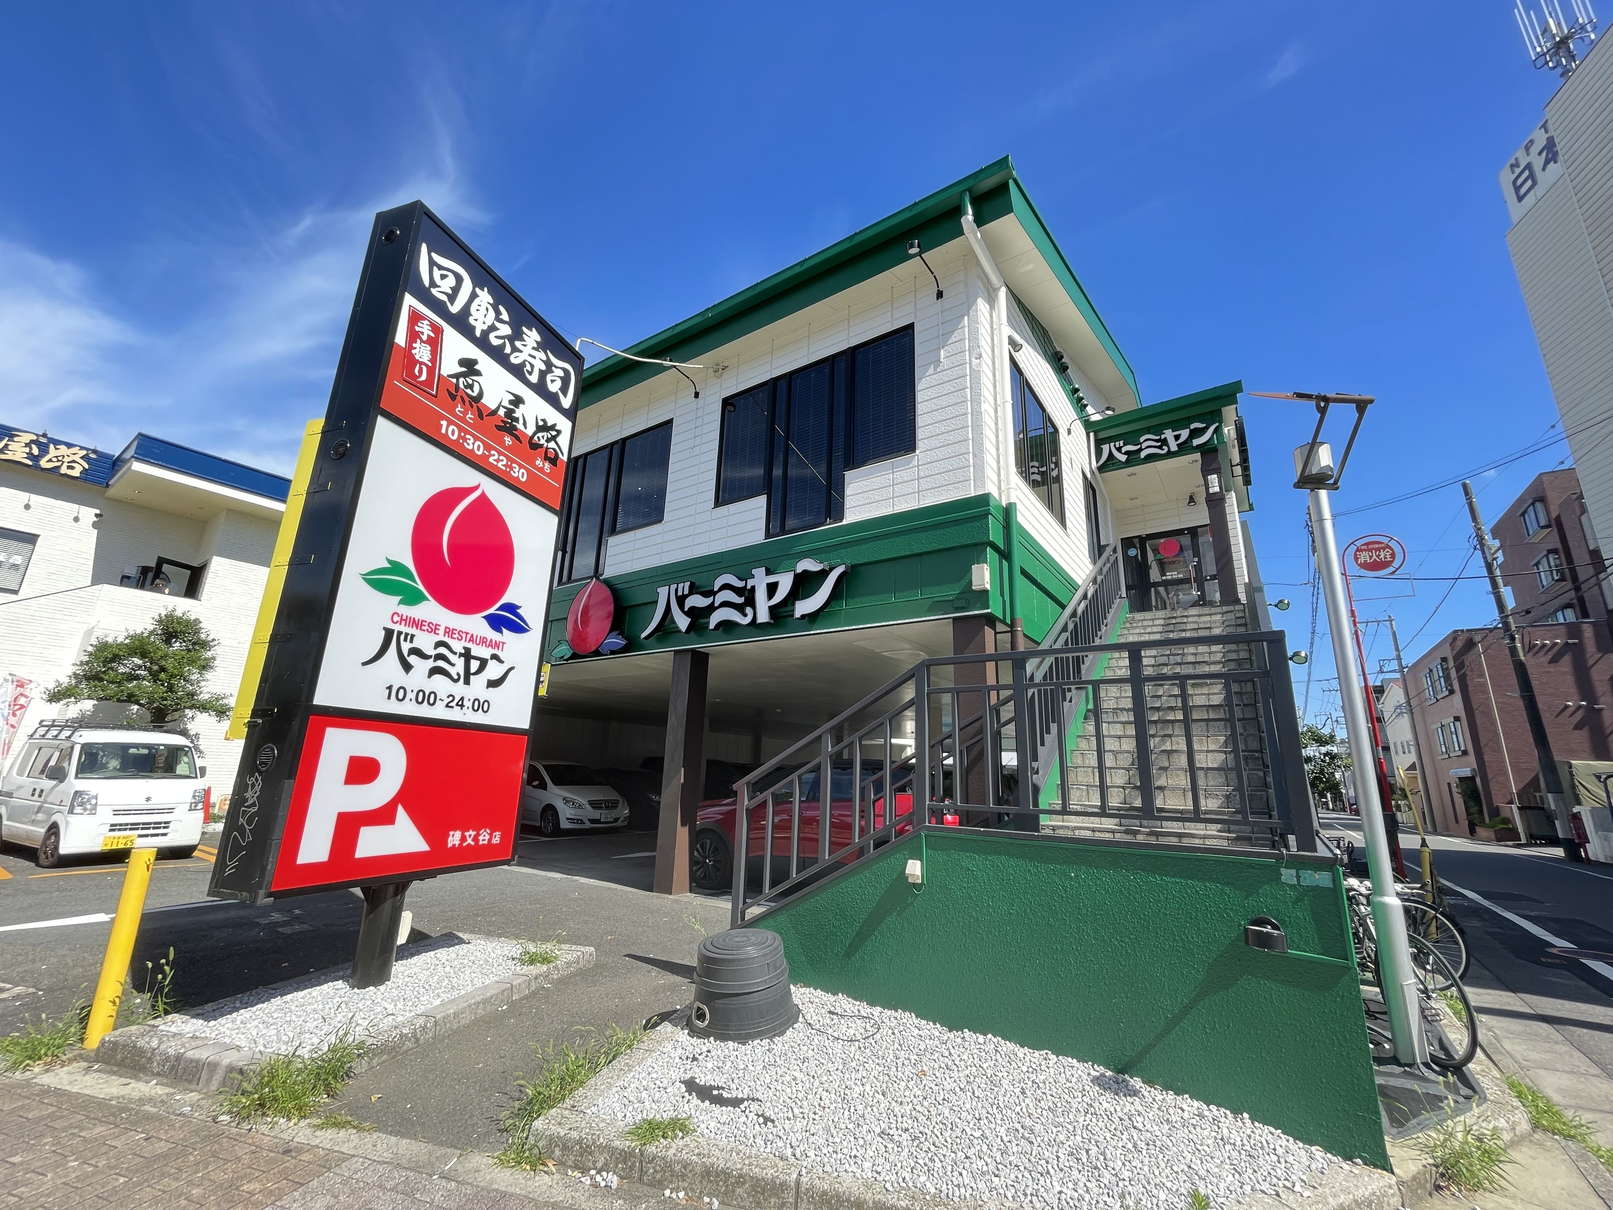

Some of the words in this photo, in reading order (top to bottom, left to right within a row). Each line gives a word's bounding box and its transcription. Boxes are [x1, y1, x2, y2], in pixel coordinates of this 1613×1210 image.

[411, 319, 435, 382] 手握り
[419, 242, 576, 410] 回転寿司
[1096, 421, 1220, 468] バーミヤン
[1356, 548, 1394, 565] 消火栓
[640, 557, 849, 640] バーミヤン
[361, 626, 516, 690] バーミヤン
[390, 611, 441, 636] CHINESE
[443, 625, 507, 652] RESTAURANT
[296, 727, 407, 864] P
[447, 829, 502, 849] 碑文谷店
